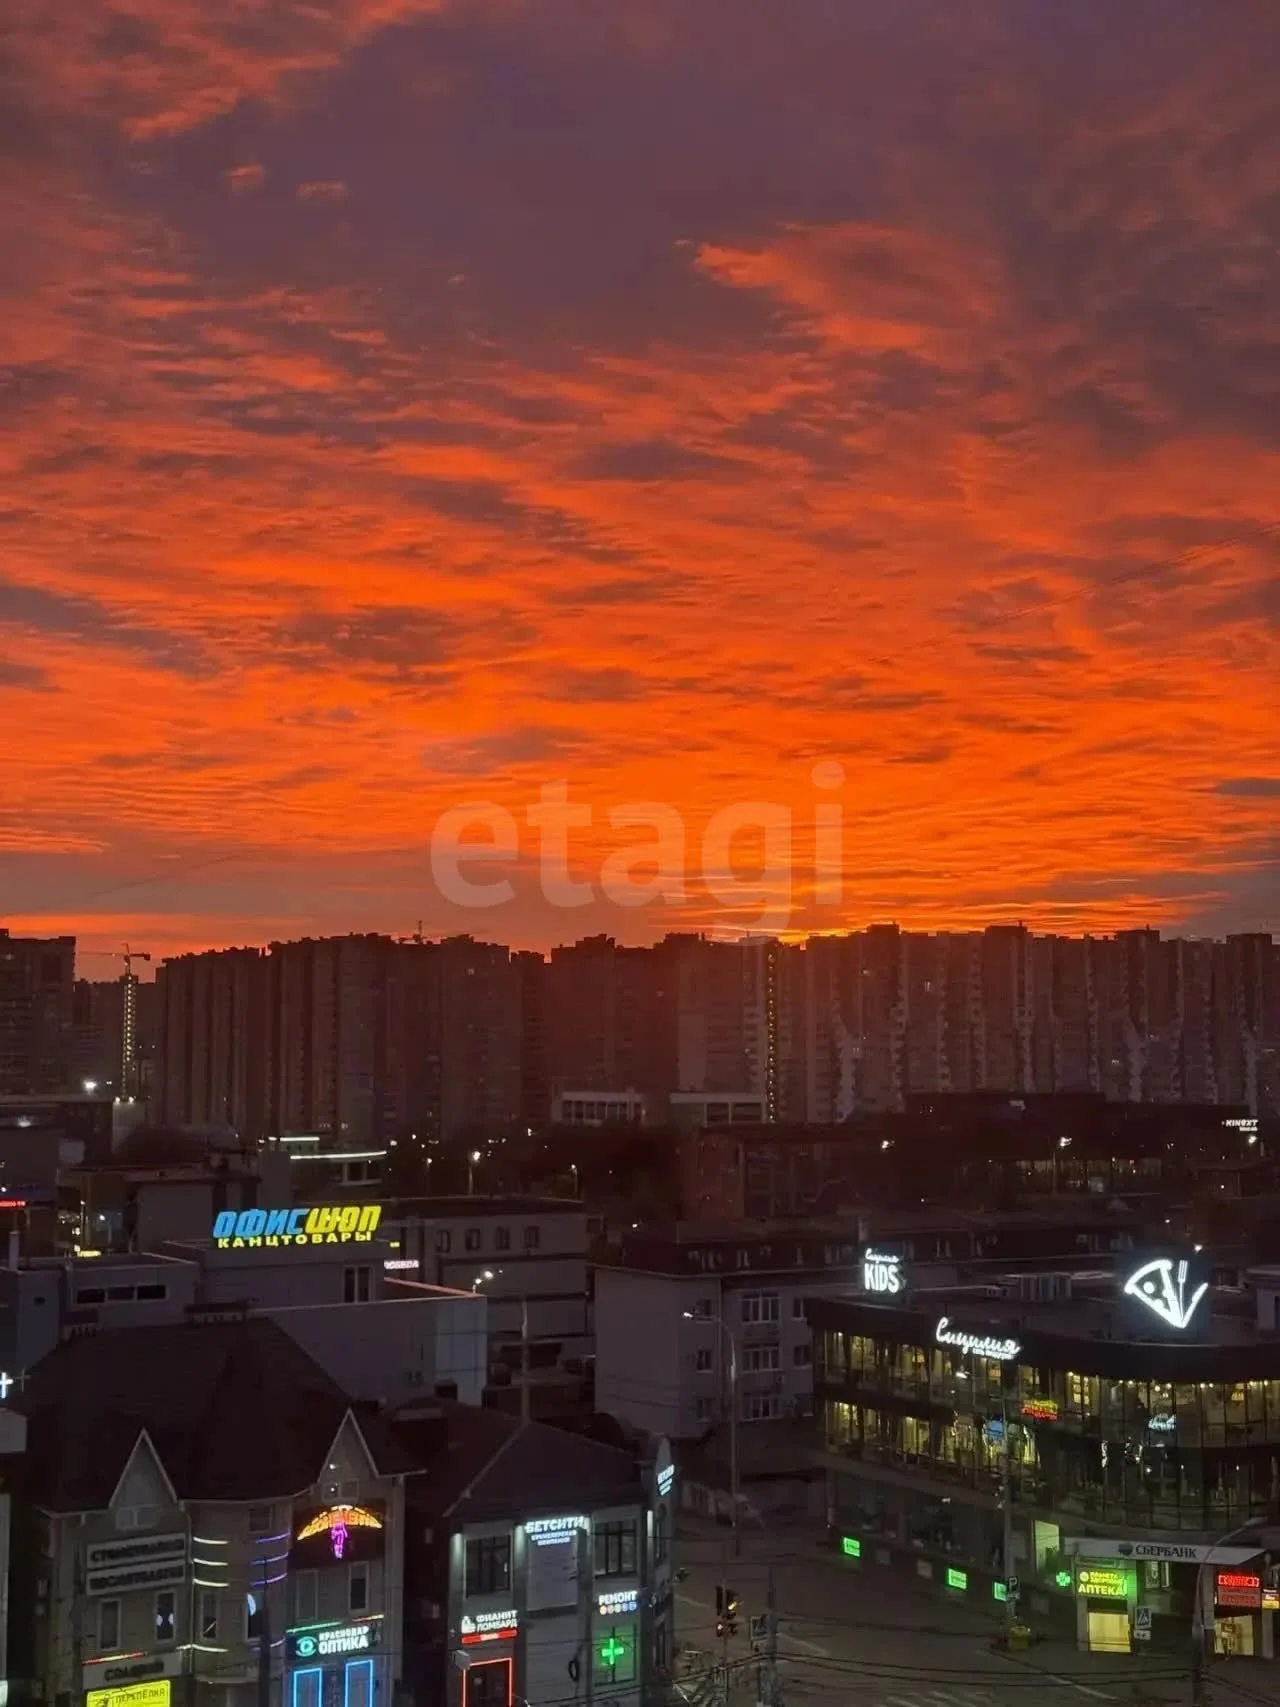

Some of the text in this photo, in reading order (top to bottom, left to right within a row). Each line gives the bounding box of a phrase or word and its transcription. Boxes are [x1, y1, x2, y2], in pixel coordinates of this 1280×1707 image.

[217, 1231, 372, 1249] КАНЦТОВАРЫ
[864, 1262, 900, 1293] KIDS
[936, 1316, 1021, 1355] Сицилия
[524, 1515, 584, 1534] БЕТСИТИ
[1135, 1545, 1197, 1558] СБЕРБАНК
[598, 1590, 637, 1606] РЕМОНТ
[1078, 1583, 1125, 1596] АПТЕКА
[319, 1634, 369, 1655] ОПТИКА
